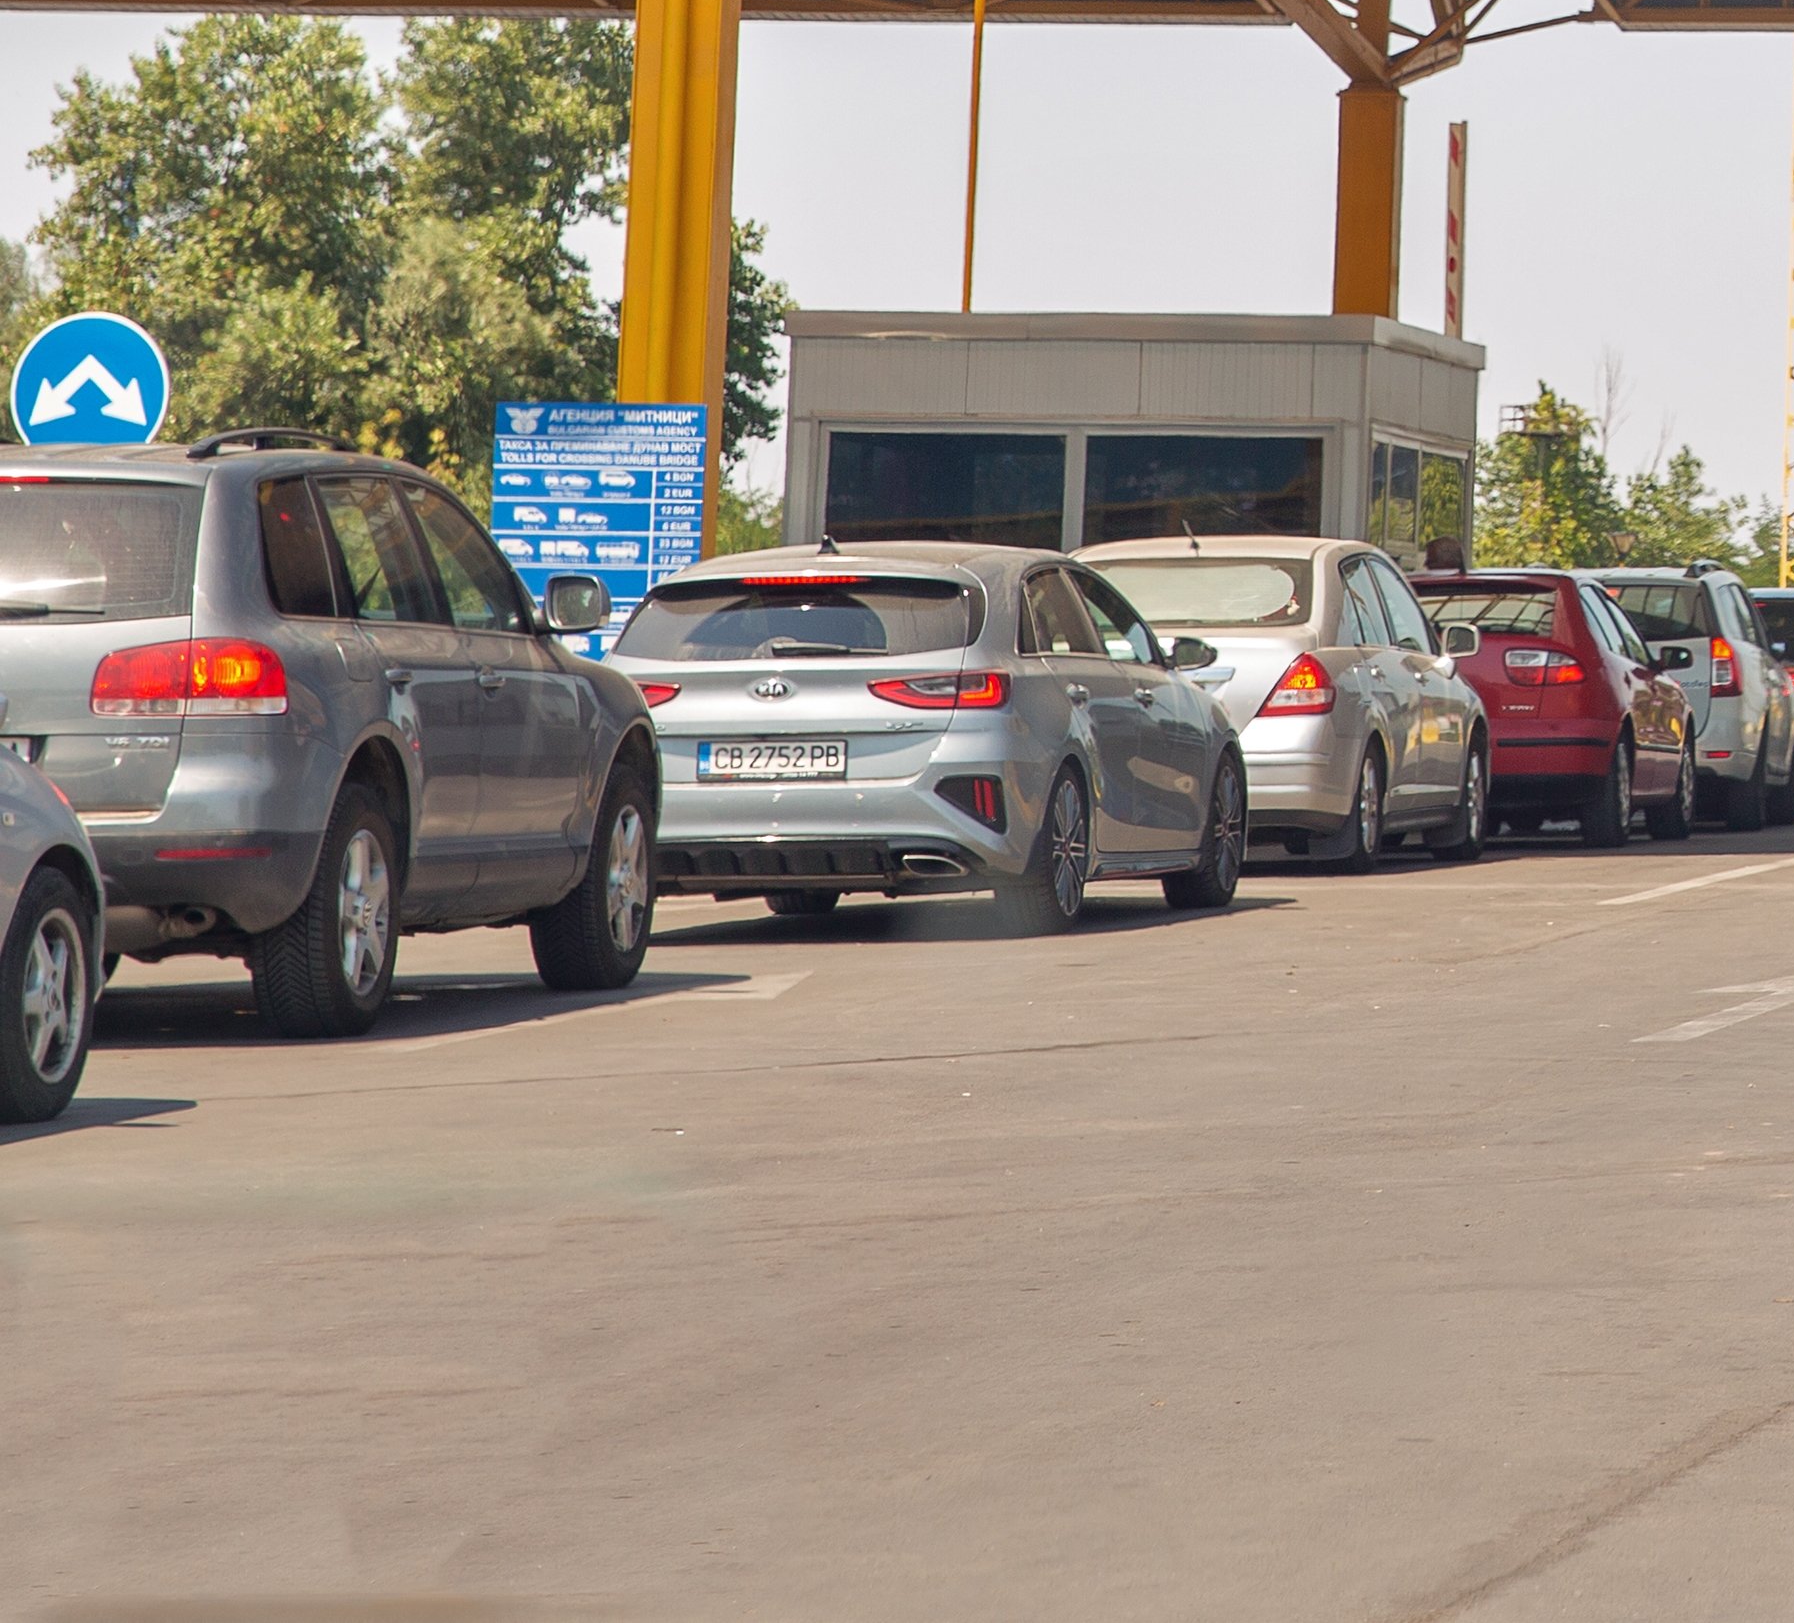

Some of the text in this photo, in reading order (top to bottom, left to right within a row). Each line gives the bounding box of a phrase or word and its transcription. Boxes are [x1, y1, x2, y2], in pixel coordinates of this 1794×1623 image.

[548, 409, 615, 423] АГЕНЦИЯ
[606, 426, 655, 437] CUSTOMS
[656, 426, 698, 437] AGENCY
[499, 439, 533, 451] ТАКСА
[534, 440, 549, 452] ЗА
[632, 442, 670, 455] ДУНАВ
[670, 443, 702, 454] МОСТ
[501, 452, 534, 463] TOLLS
[535, 452, 558, 464] FOR
[614, 454, 657, 466] DANUBE
[658, 455, 698, 467] BRIDGE
[672, 472, 695, 482] BGN
[672, 488, 693, 499] EUR
[714, 746, 743, 770] CB
[748, 746, 806, 769] 2752
[809, 744, 840, 768] PB
